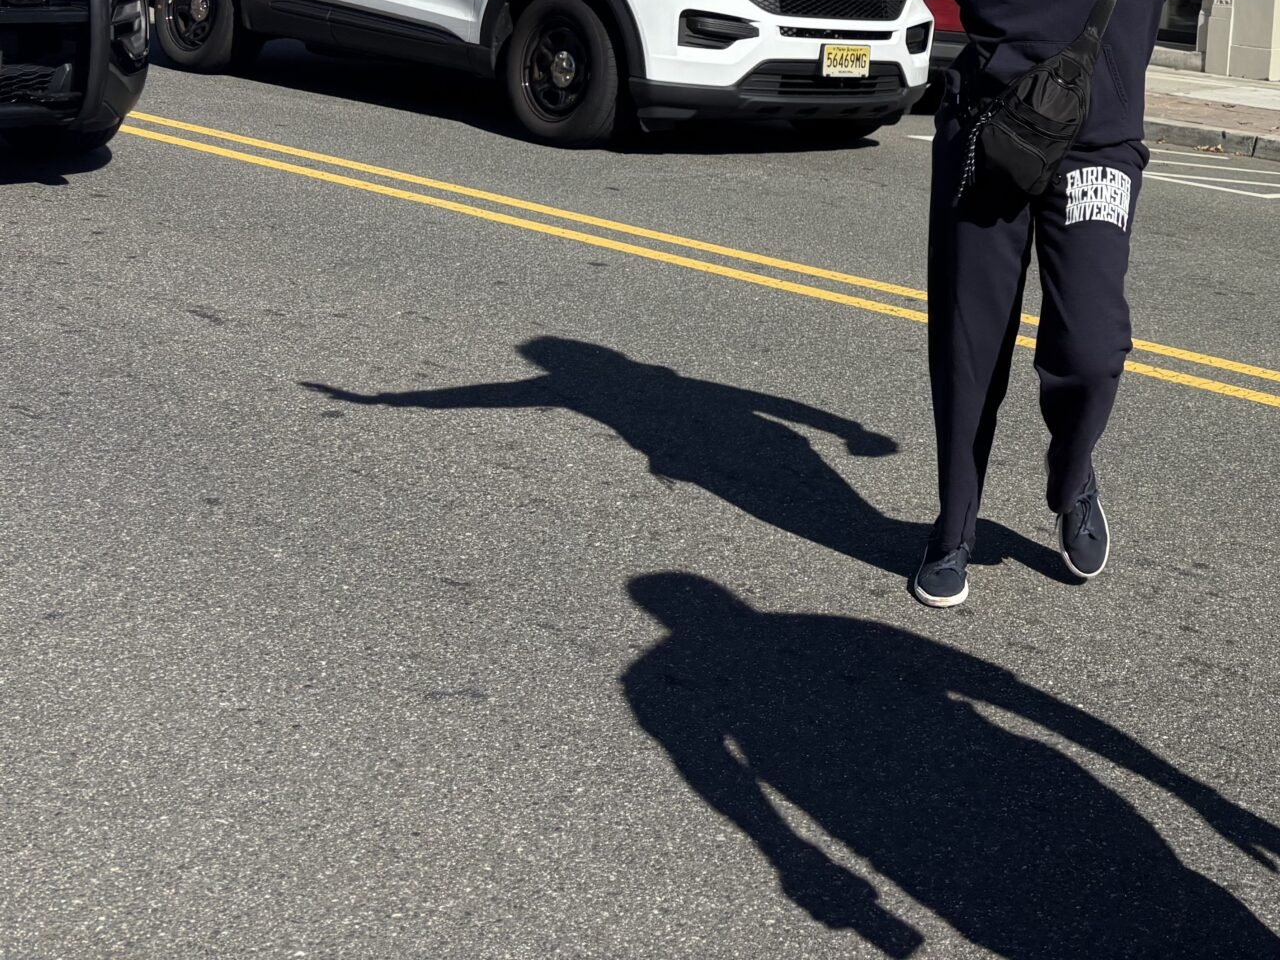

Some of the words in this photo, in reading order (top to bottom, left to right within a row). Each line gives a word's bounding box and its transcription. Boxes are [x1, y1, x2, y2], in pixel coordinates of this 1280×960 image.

[827, 53, 867, 69] 56469MG
[1066, 166, 1131, 195] FAIRLEIGH
[1066, 184, 1131, 214] DICKINSON
[1065, 201, 1128, 232] UNIVERSITY
